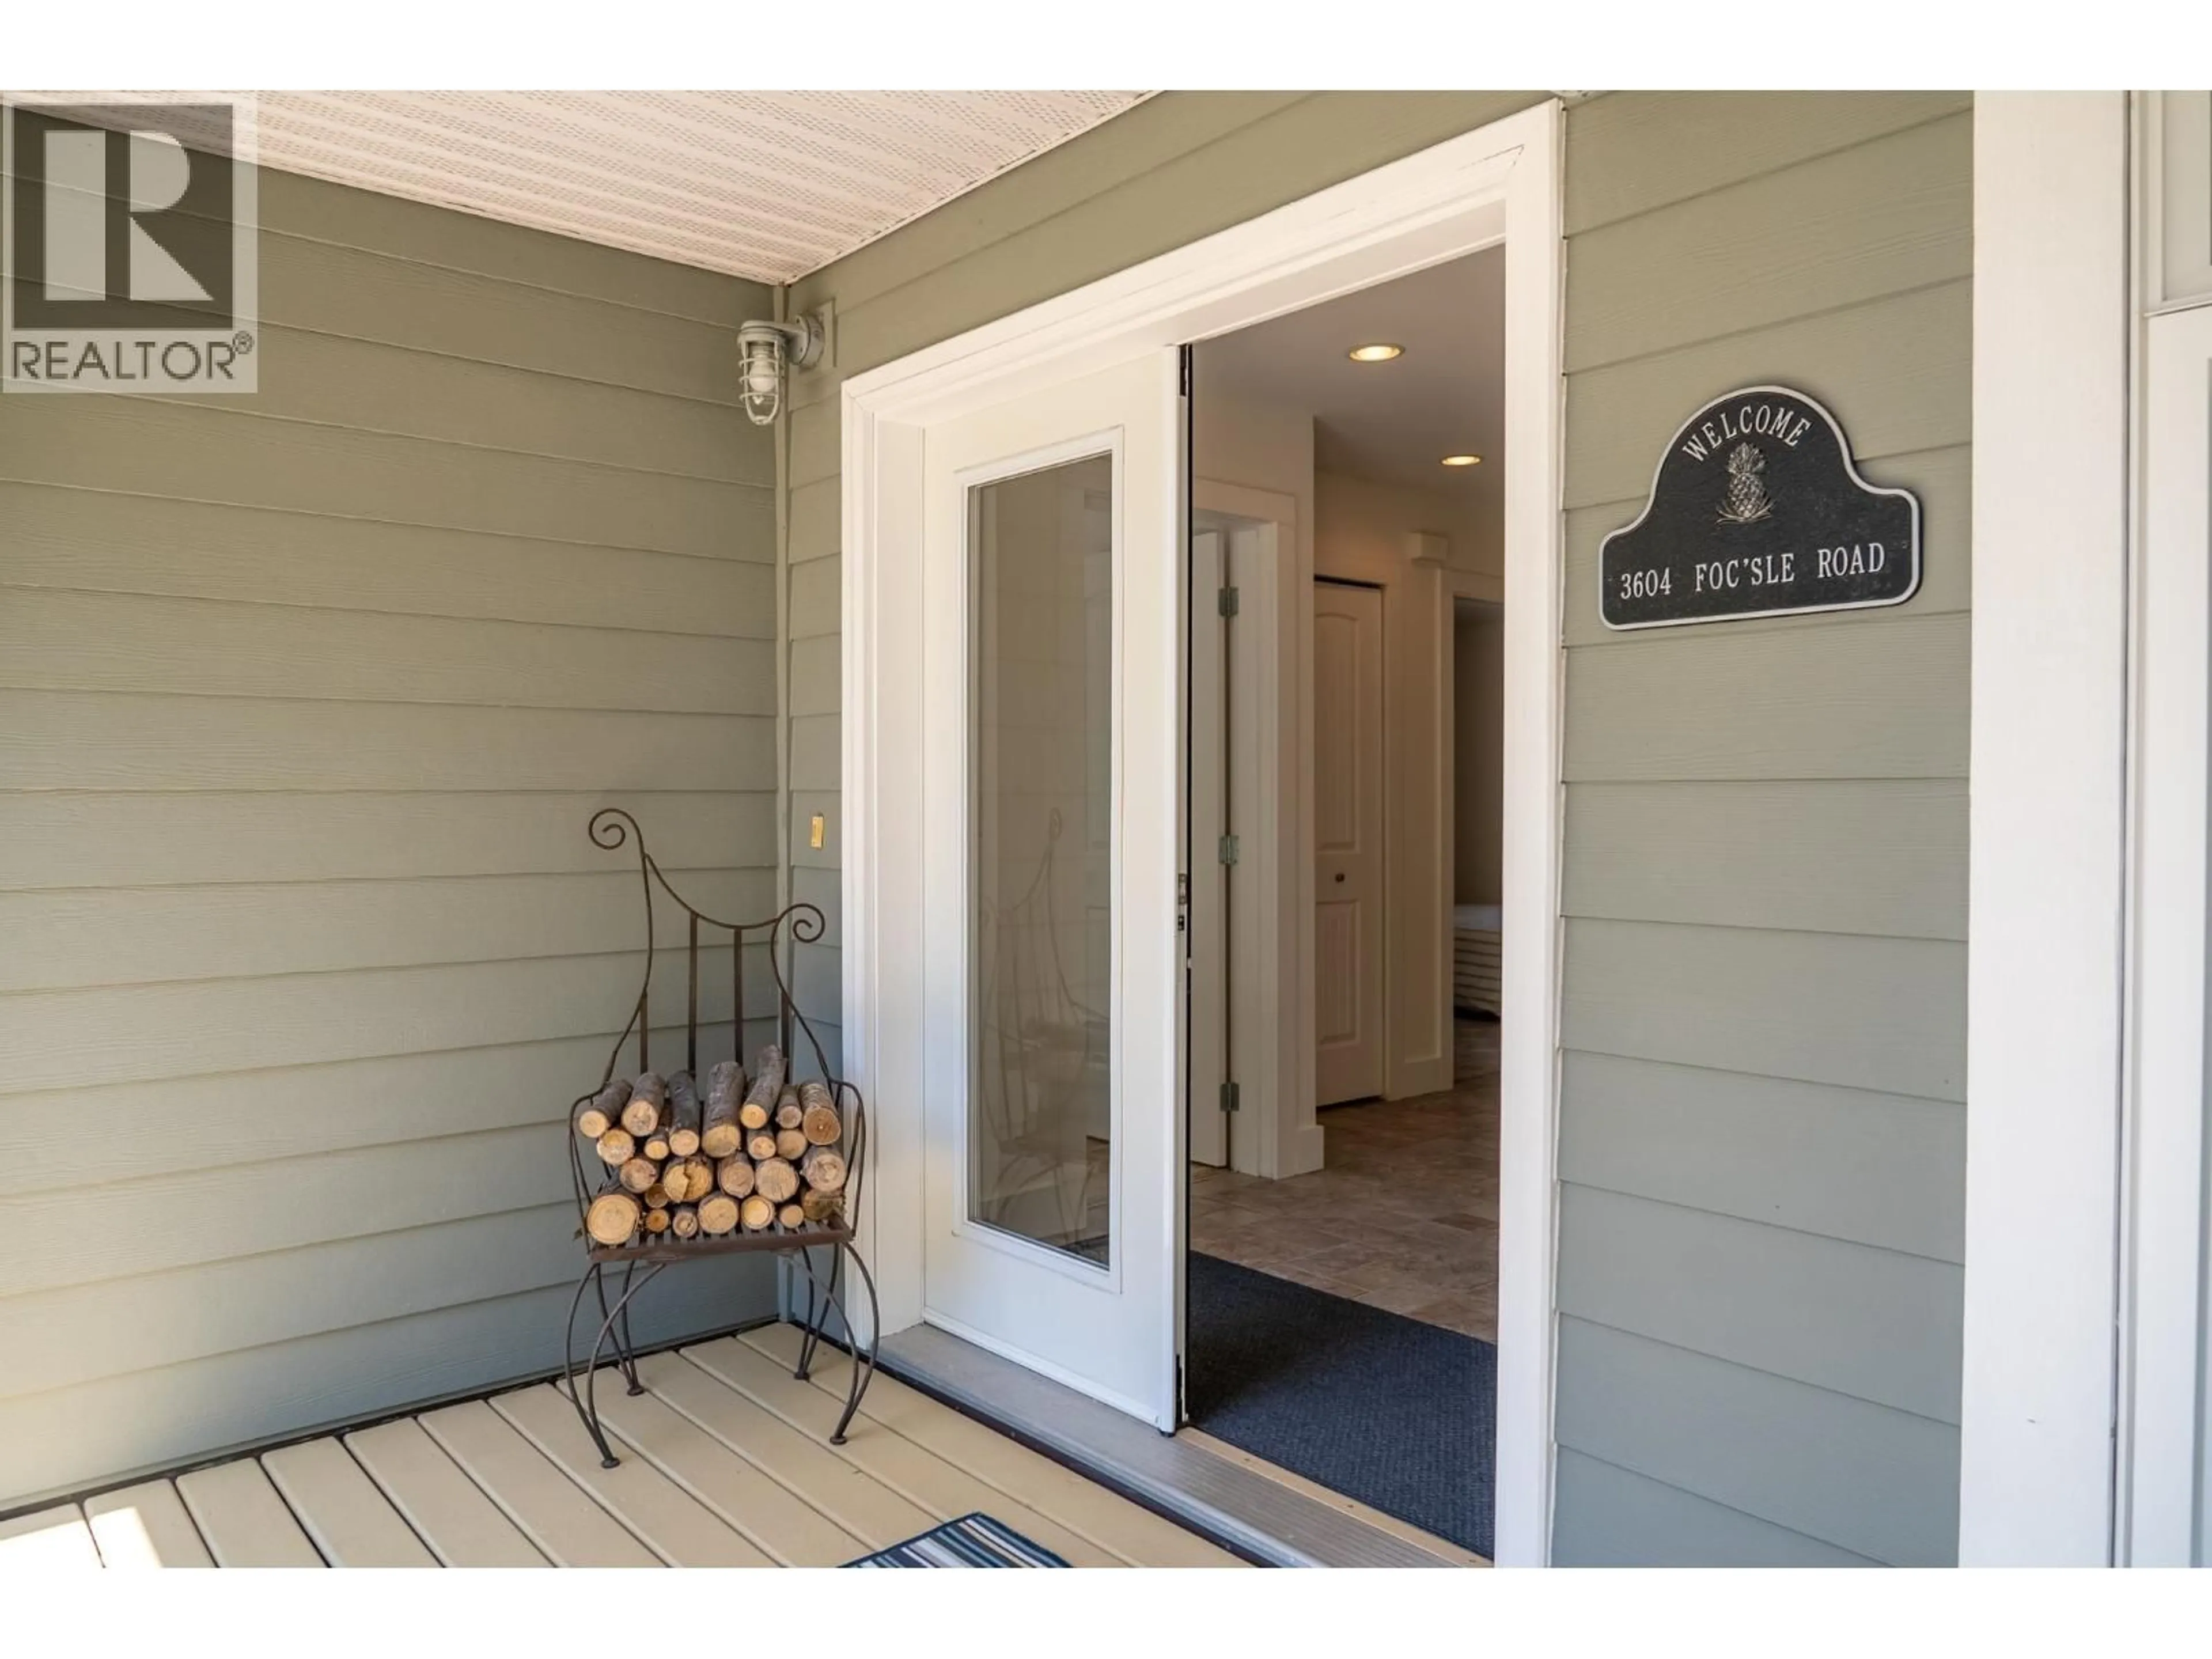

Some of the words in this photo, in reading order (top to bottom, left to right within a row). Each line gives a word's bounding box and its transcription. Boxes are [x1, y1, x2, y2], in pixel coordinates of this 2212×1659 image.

[1682, 404, 1812, 462] WELCOME
[1620, 567, 1672, 600] 3604
[1695, 553, 1796, 592] FOC'SLE
[1817, 543, 1885, 578] ROAD
